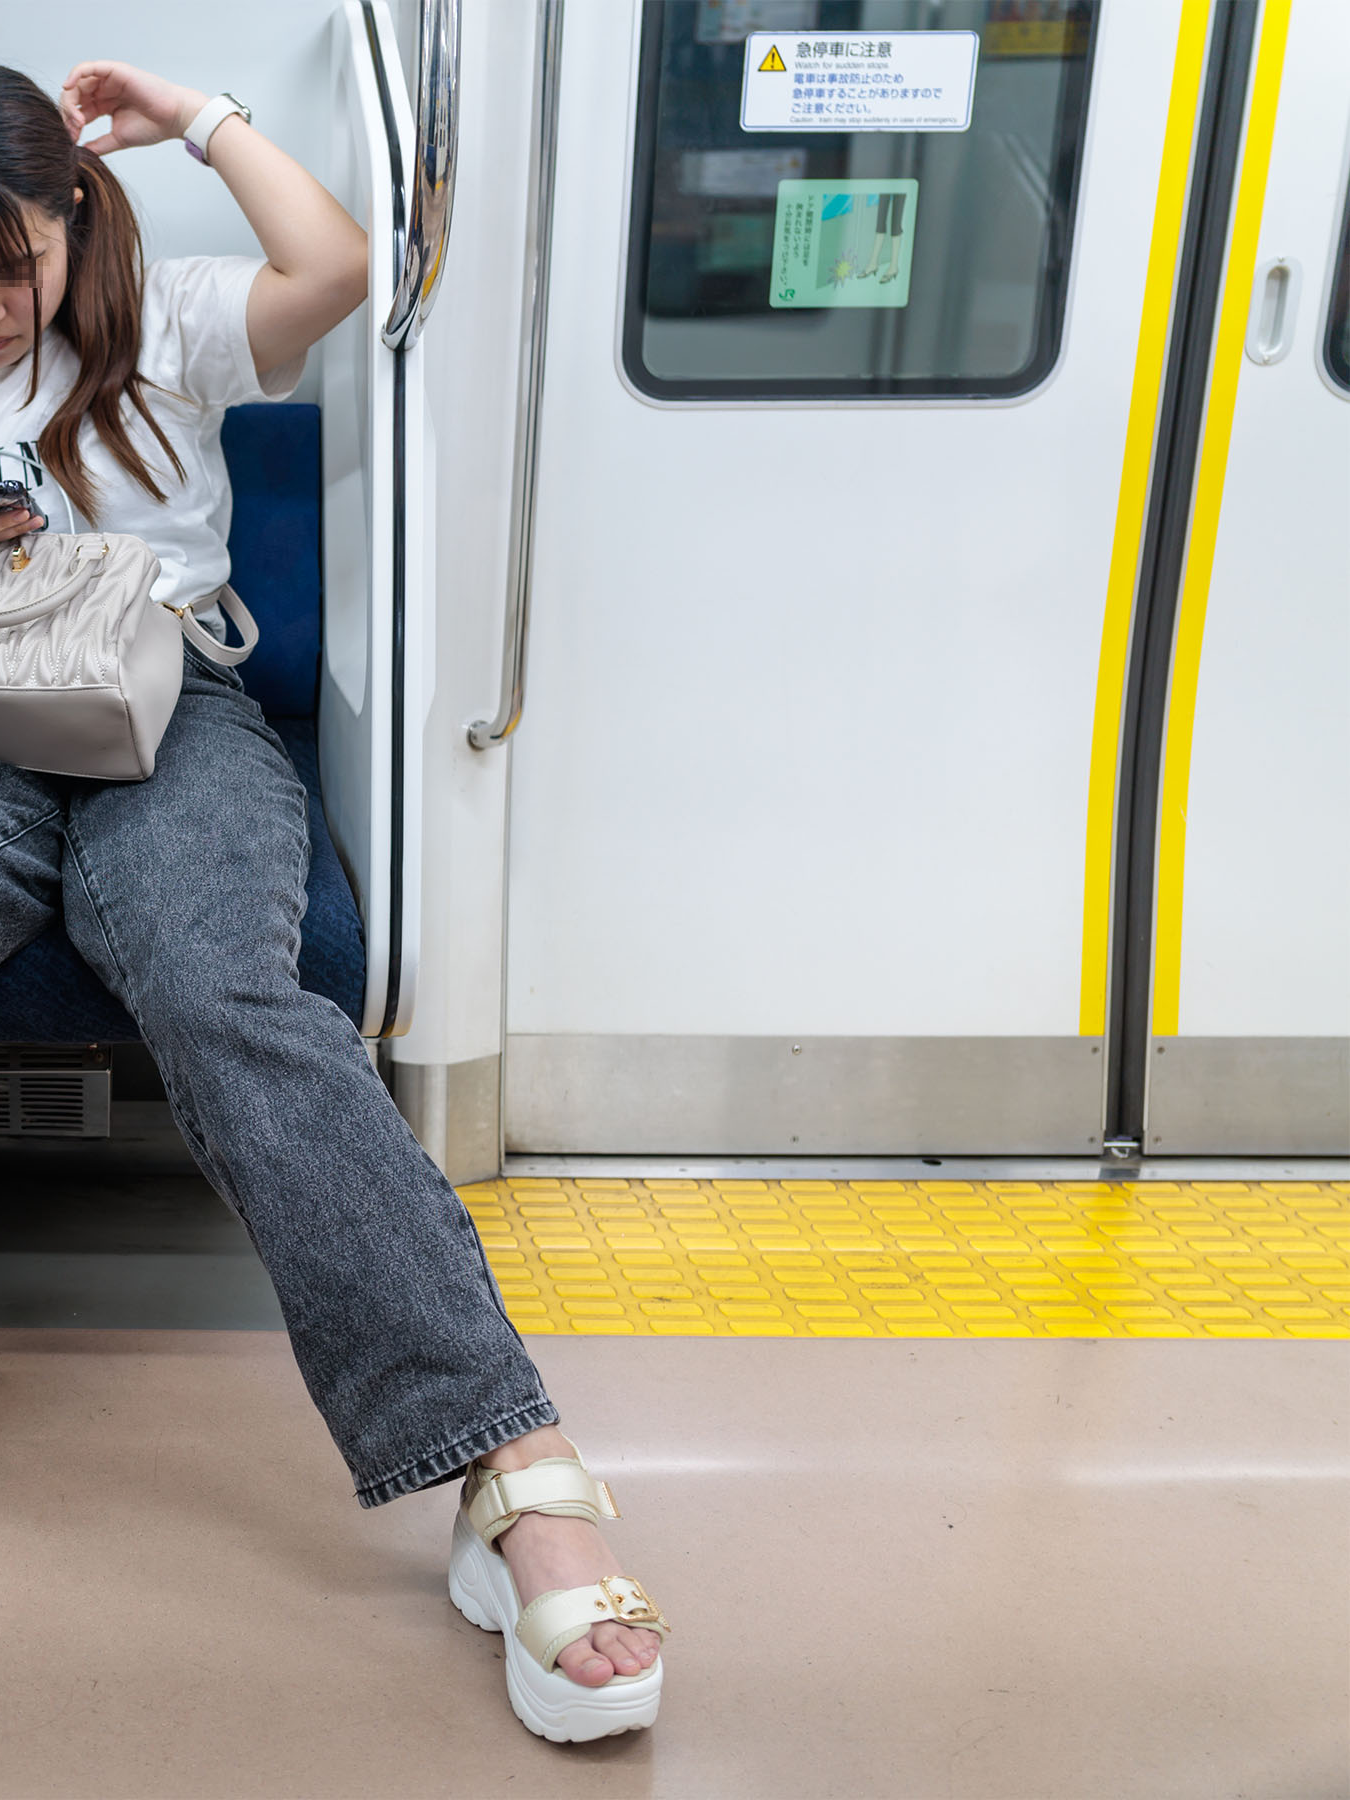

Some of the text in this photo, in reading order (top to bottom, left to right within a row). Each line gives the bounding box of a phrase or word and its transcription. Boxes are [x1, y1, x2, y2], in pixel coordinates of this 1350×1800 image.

[795, 41, 892, 58] 急停車に注意
[794, 62, 820, 70] Watch
[835, 62, 864, 70] sudden
[794, 73, 904, 84] 電車は事故防止のため
[792, 87, 943, 99] 急停車することがありますので
[791, 102, 871, 114] ご注意ください。
[778, 288, 796, 301] JR
